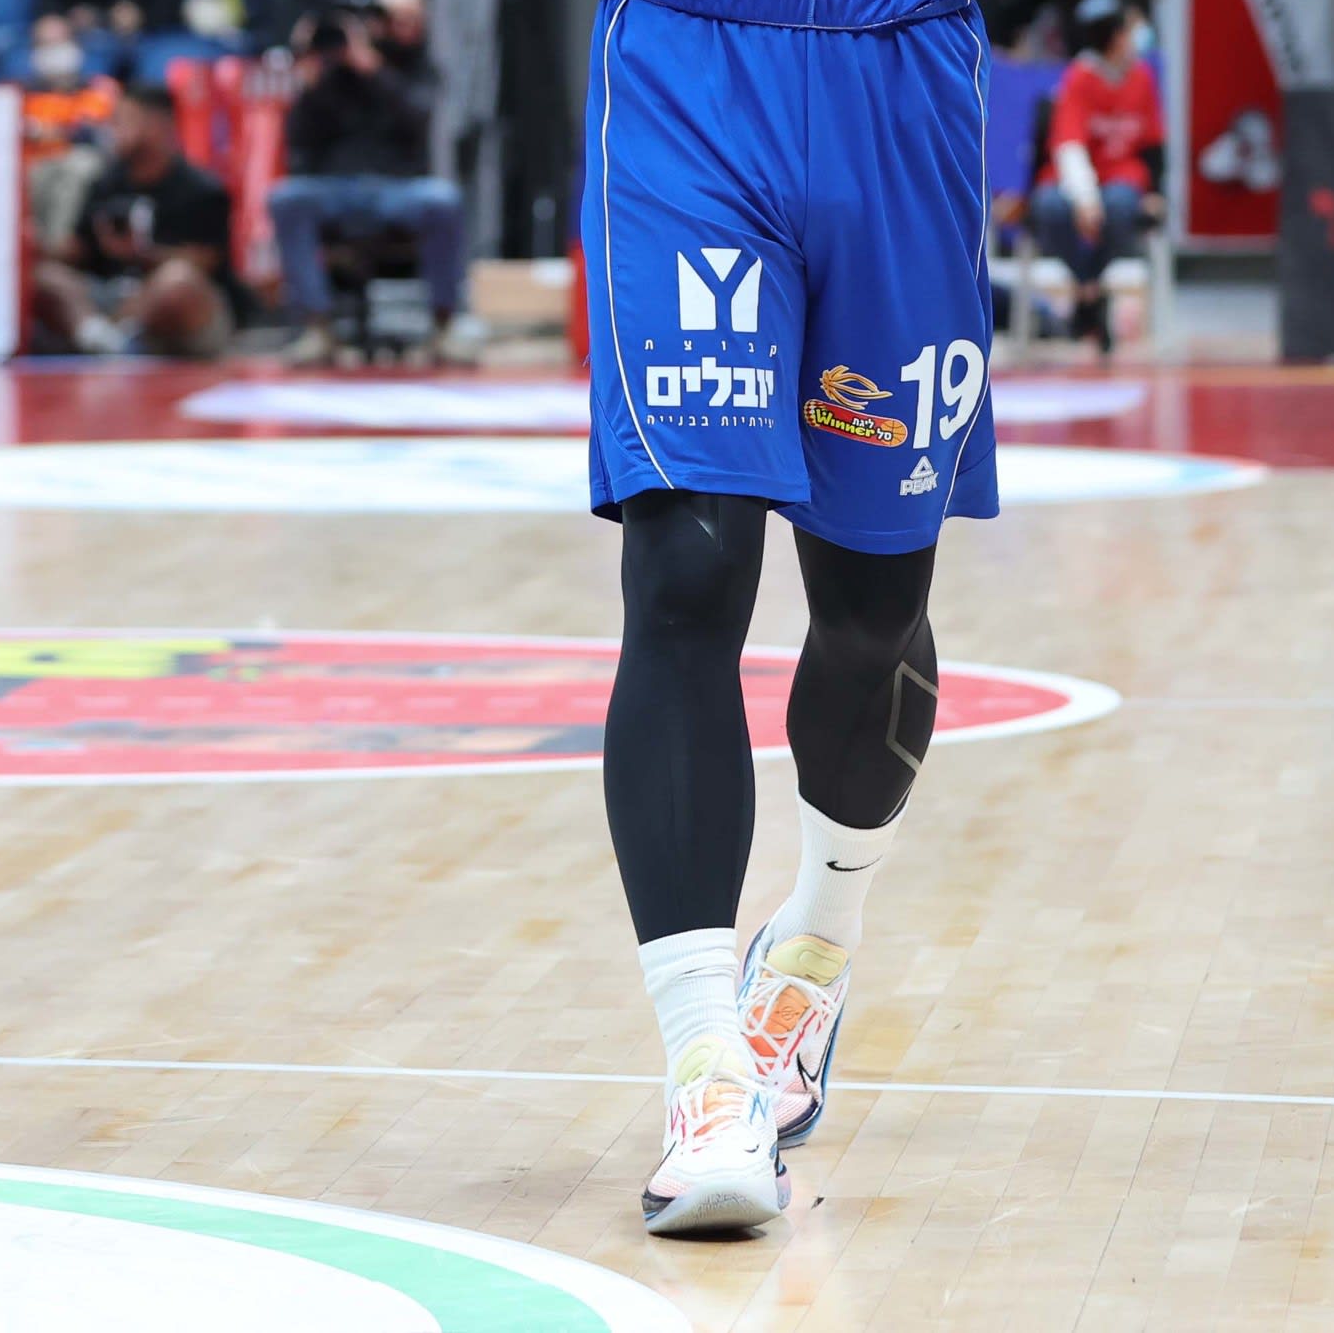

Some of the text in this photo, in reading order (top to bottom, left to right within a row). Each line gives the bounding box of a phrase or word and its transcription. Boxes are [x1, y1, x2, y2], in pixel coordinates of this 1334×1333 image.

[645, 338, 778, 358] קבוצת
[646, 356, 774, 409] יובלים
[900, 338, 985, 450] 19
[815, 408, 893, 441] Winner סל
[852, 416, 875, 429] ליגת
[899, 472, 939, 496] PEAK
